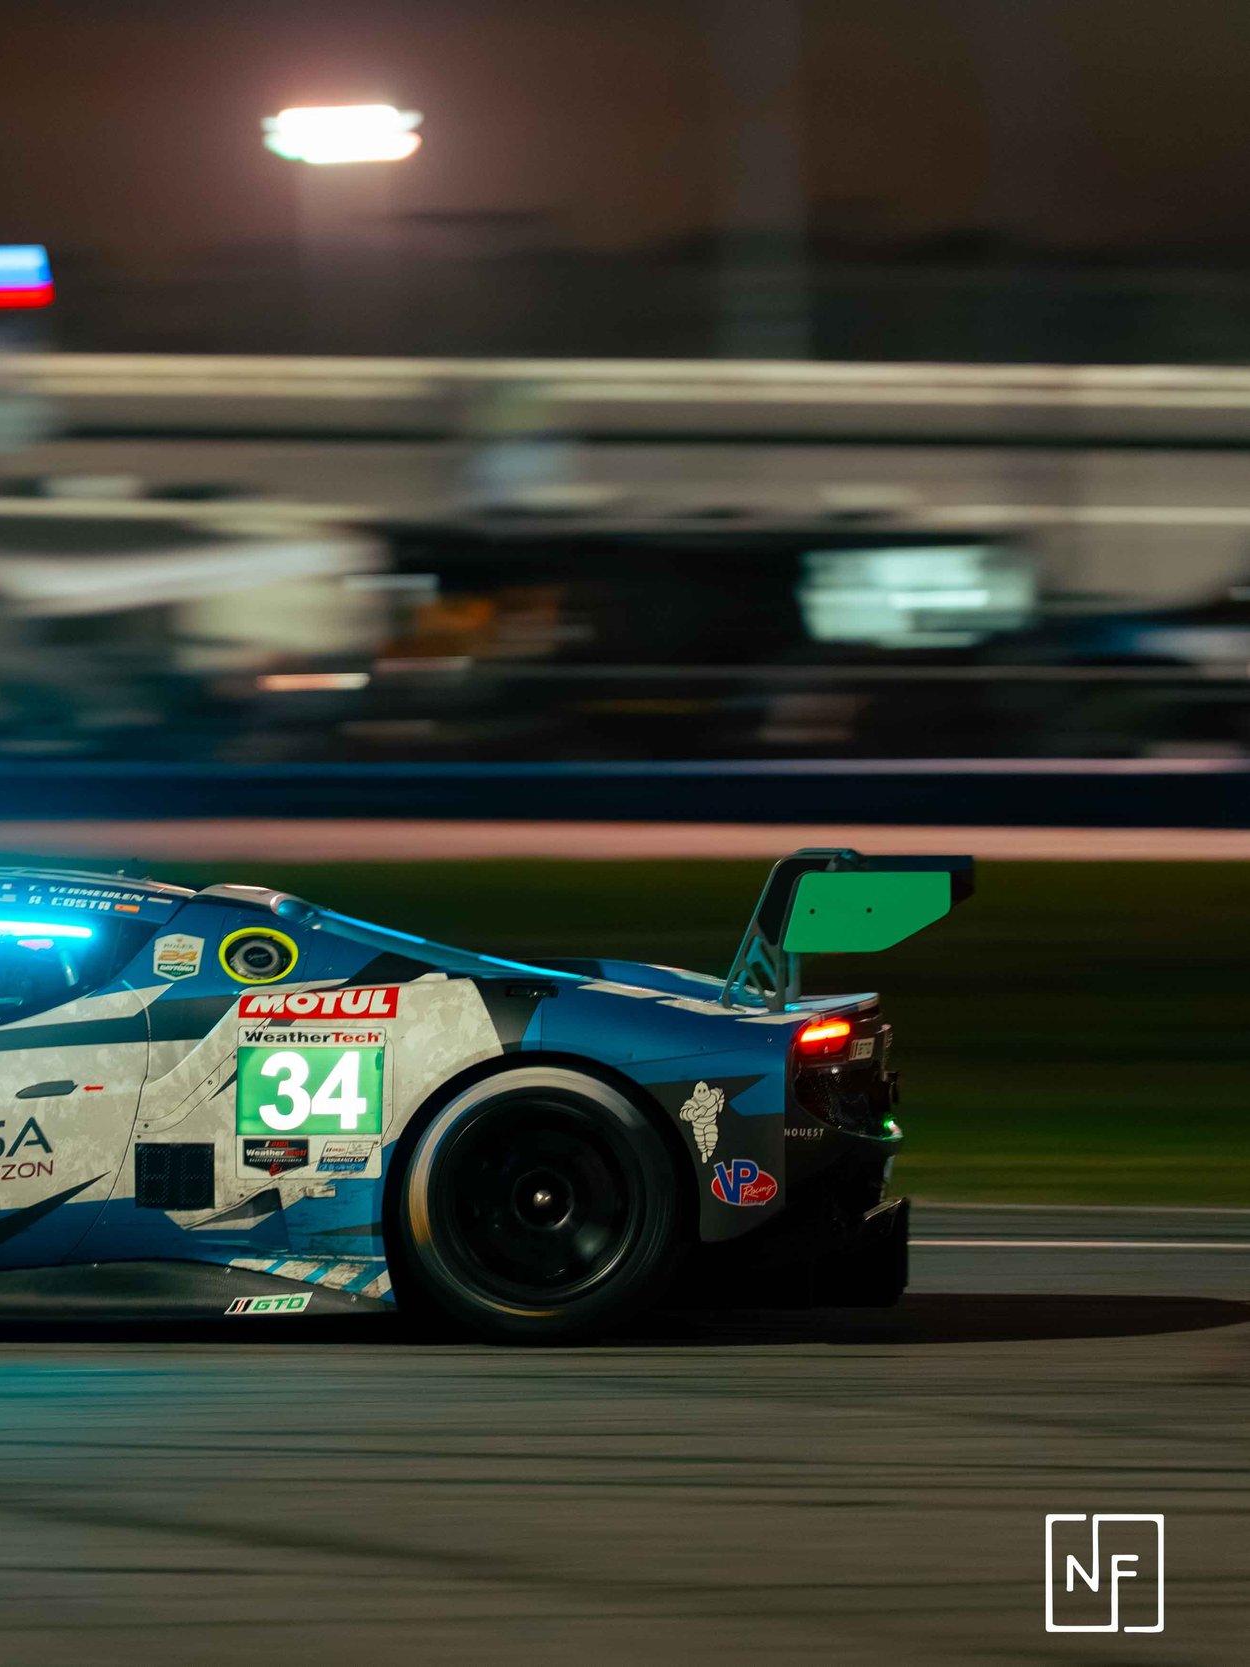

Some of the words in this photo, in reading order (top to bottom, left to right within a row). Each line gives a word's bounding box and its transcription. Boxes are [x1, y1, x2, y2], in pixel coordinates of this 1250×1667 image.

[49, 886, 145, 902] VERMEULEN
[50, 897, 111, 911] COSTA
[245, 990, 390, 1015] MOTUL
[245, 1030, 382, 1043] WeatherTech
[258, 1051, 367, 1131] 34
[713, 1159, 760, 1206] VP
[252, 1297, 305, 1311] GTD
